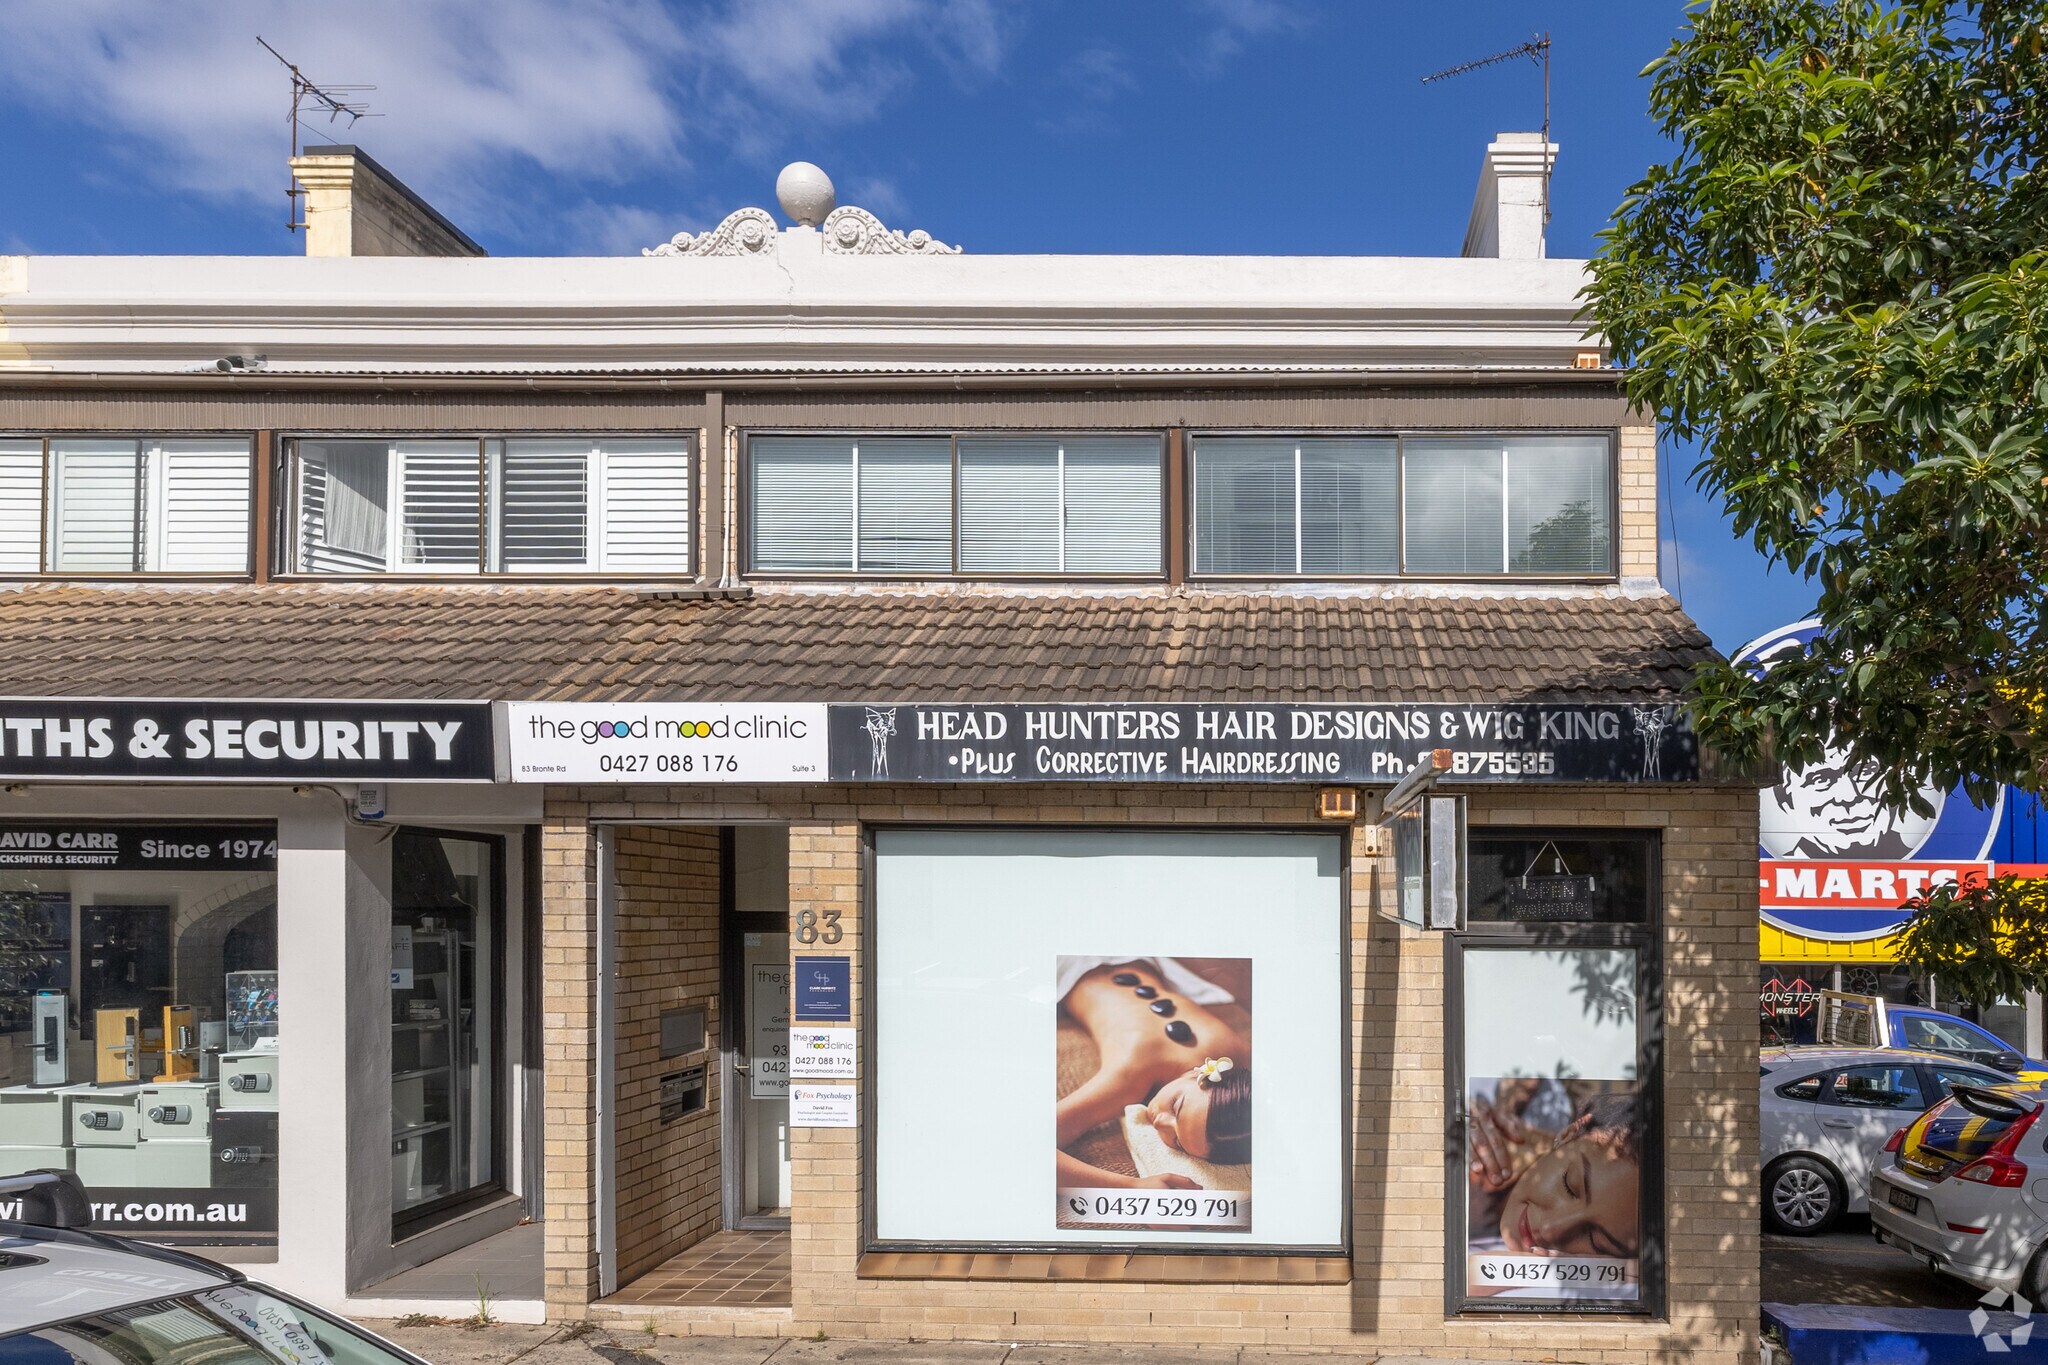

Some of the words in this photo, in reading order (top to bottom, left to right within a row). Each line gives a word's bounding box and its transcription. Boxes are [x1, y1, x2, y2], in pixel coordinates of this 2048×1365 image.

[529, 715, 575, 738] the
[581, 715, 648, 745] good
[655, 715, 729, 738] mood
[734, 715, 807, 738] clinic
[917, 711, 1008, 740] HEAD
[1025, 711, 1181, 740] HUNTERS
[1196, 711, 1278, 740] HAIR
[1291, 711, 1430, 740] DESIGNS
[1440, 713, 1459, 739] &
[1467, 711, 1524, 740] WIG
[1539, 711, 1620, 740] KING
[0, 717, 114, 758] THS
[128, 718, 172, 759] &
[185, 719, 463, 761] SECURITY
[521, 765, 531, 773] 83
[532, 765, 555, 773] Bronte
[556, 765, 567, 773] Rd
[600, 755, 649, 772] 0427
[657, 755, 694, 772] 088
[702, 755, 738, 772] 176
[792, 765, 809, 773] Suite
[810, 765, 816, 773] 3
[0, 832, 52, 848] AVID
[57, 832, 119, 849] CARR
[140, 840, 211, 858] Since
[219, 840, 278, 858] 1974
[55, 855, 63, 864] &
[65, 855, 118, 864] SECURITY
[1526, 885, 1574, 899] OPEN
[795, 909, 843, 944] 83
[758, 971, 780, 982] the
[809, 1034, 830, 1044] good
[762, 1061, 790, 1072] 042
[795, 1057, 815, 1065] 0427
[818, 1057, 833, 1065] 088
[837, 1057, 852, 1065] 176
[816, 1092, 852, 1100] Psychology
[1095, 1196, 1150, 1215] 0437
[1157, 1197, 1197, 1217] 529
[1204, 1198, 1237, 1217] 791
[1503, 1263, 1550, 1280] 0437
[1556, 1264, 1591, 1281] 529
[1596, 1265, 1626, 1282] 791
